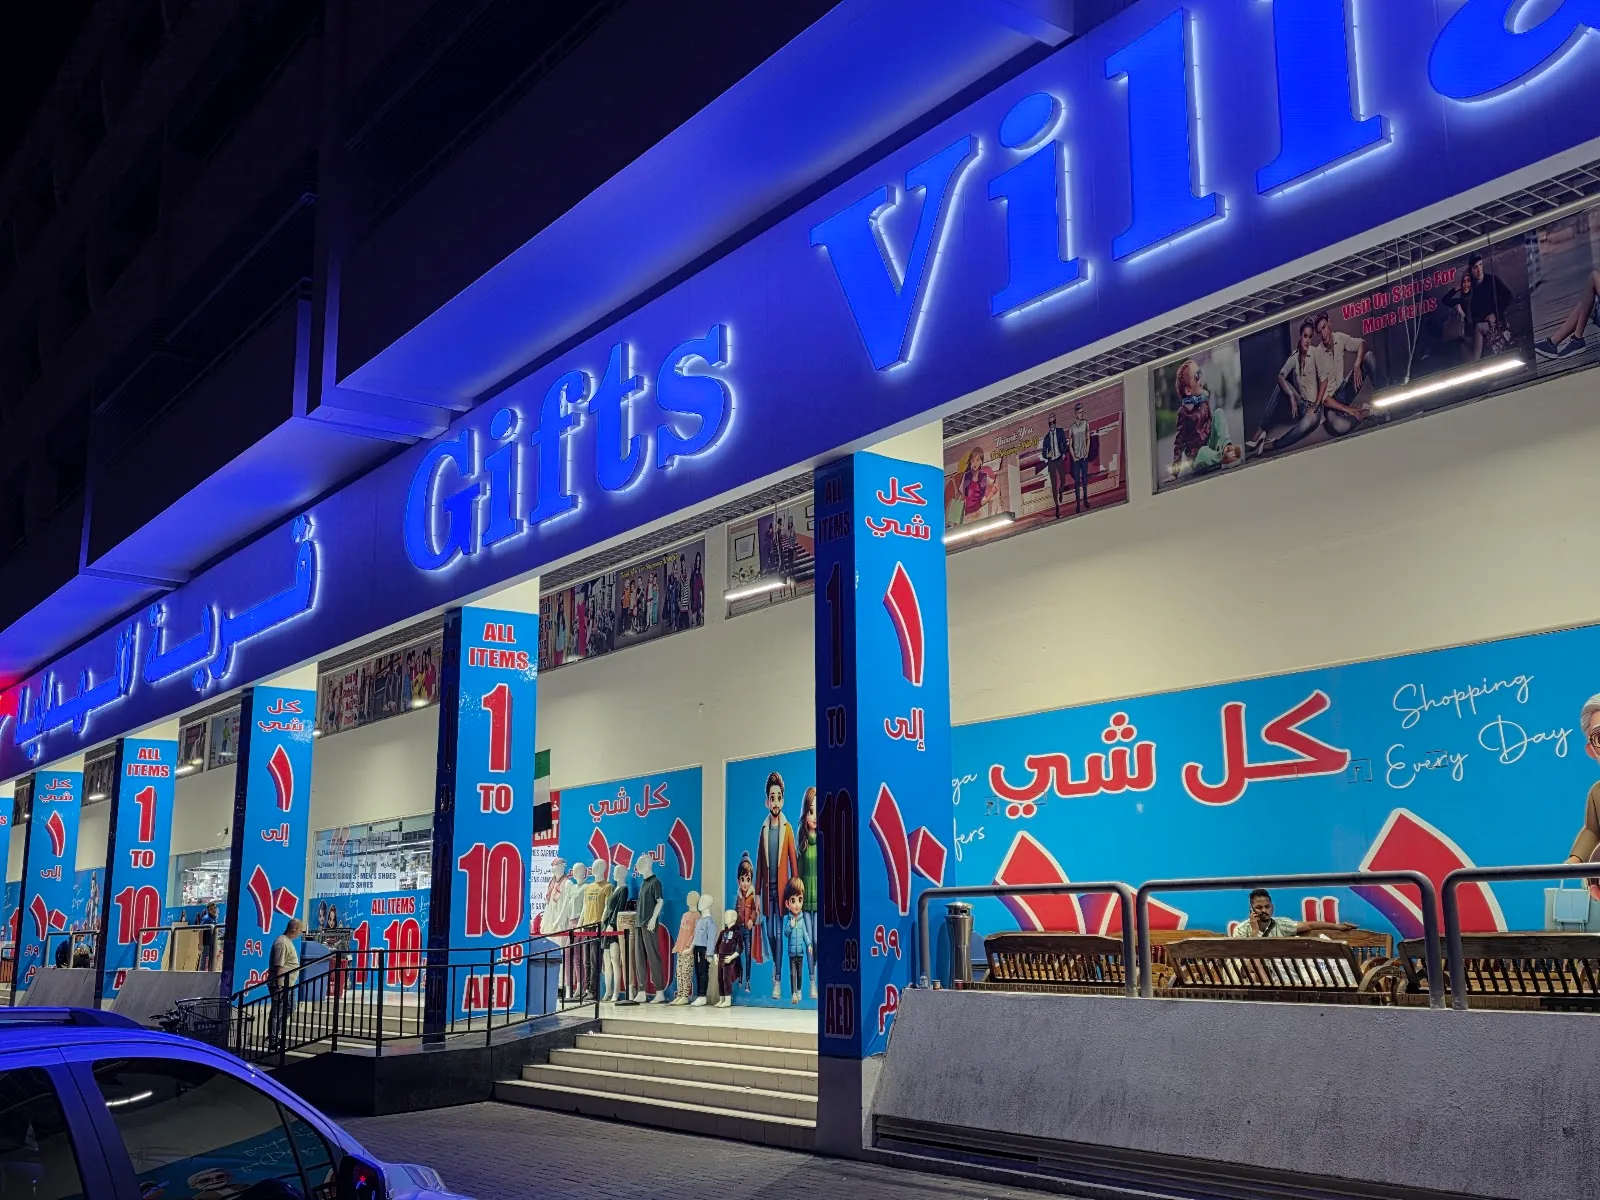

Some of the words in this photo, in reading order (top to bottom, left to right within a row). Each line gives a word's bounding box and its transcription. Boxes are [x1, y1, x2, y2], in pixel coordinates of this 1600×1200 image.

[1341, 297, 1371, 321] Visit
[1372, 290, 1390, 310] Up
[1391, 277, 1432, 303] Stairs
[1433, 266, 1456, 288] For
[1362, 310, 1397, 335] More
[1397, 296, 1437, 324] Items
[404, 323, 737, 573] Gifts
[994, 433, 1018, 449] Thank
[876, 477, 927, 508] كل
[818, 514, 851, 545] ITEMS
[865, 514, 931, 543] شي
[483, 622, 516, 645] ALL
[825, 562, 844, 689] 1
[883, 561, 924, 687] ١
[469, 647, 530, 670] ITEMS
[267, 698, 302, 714] كل
[1392, 672, 1534, 729] Shopping
[258, 718, 303, 733] شي
[481, 683, 512, 773] 1
[827, 706, 847, 749] TO
[884, 707, 925, 752] إلى
[1181, 689, 1351, 805] كل
[127, 763, 169, 778] ITEMS
[137, 747, 161, 761] ALL
[988, 711, 1156, 819] شي
[1386, 743, 1468, 789] Every
[1478, 715, 1573, 765] Day
[38, 791, 73, 803] شي
[45, 778, 72, 790] كل
[266, 744, 294, 812] ١
[480, 783, 512, 814] TO
[951, 773, 978, 805] ga
[134, 786, 157, 843] 1
[588, 787, 631, 823] شي
[635, 782, 671, 818] كل
[45, 810, 66, 858] ١
[261, 823, 289, 847] إلى
[667, 817, 695, 881] ١
[869, 781, 948, 916] ١٠
[953, 817, 985, 862] fers
[40, 864, 63, 882] إلى
[130, 848, 155, 869] TO
[819, 788, 856, 930] 10
[247, 864, 299, 934] ١٠
[371, 900, 387, 915] ALL
[387, 896, 416, 914] ITEMS
[457, 842, 526, 939] 10
[29, 893, 68, 942] ١٠
[114, 885, 162, 946] 10
[353, 920, 370, 985] 1
[383, 918, 422, 988] 10
[496, 945, 522, 966] .99
[462, 975, 515, 1012] AED
[824, 983, 855, 1040] AED
